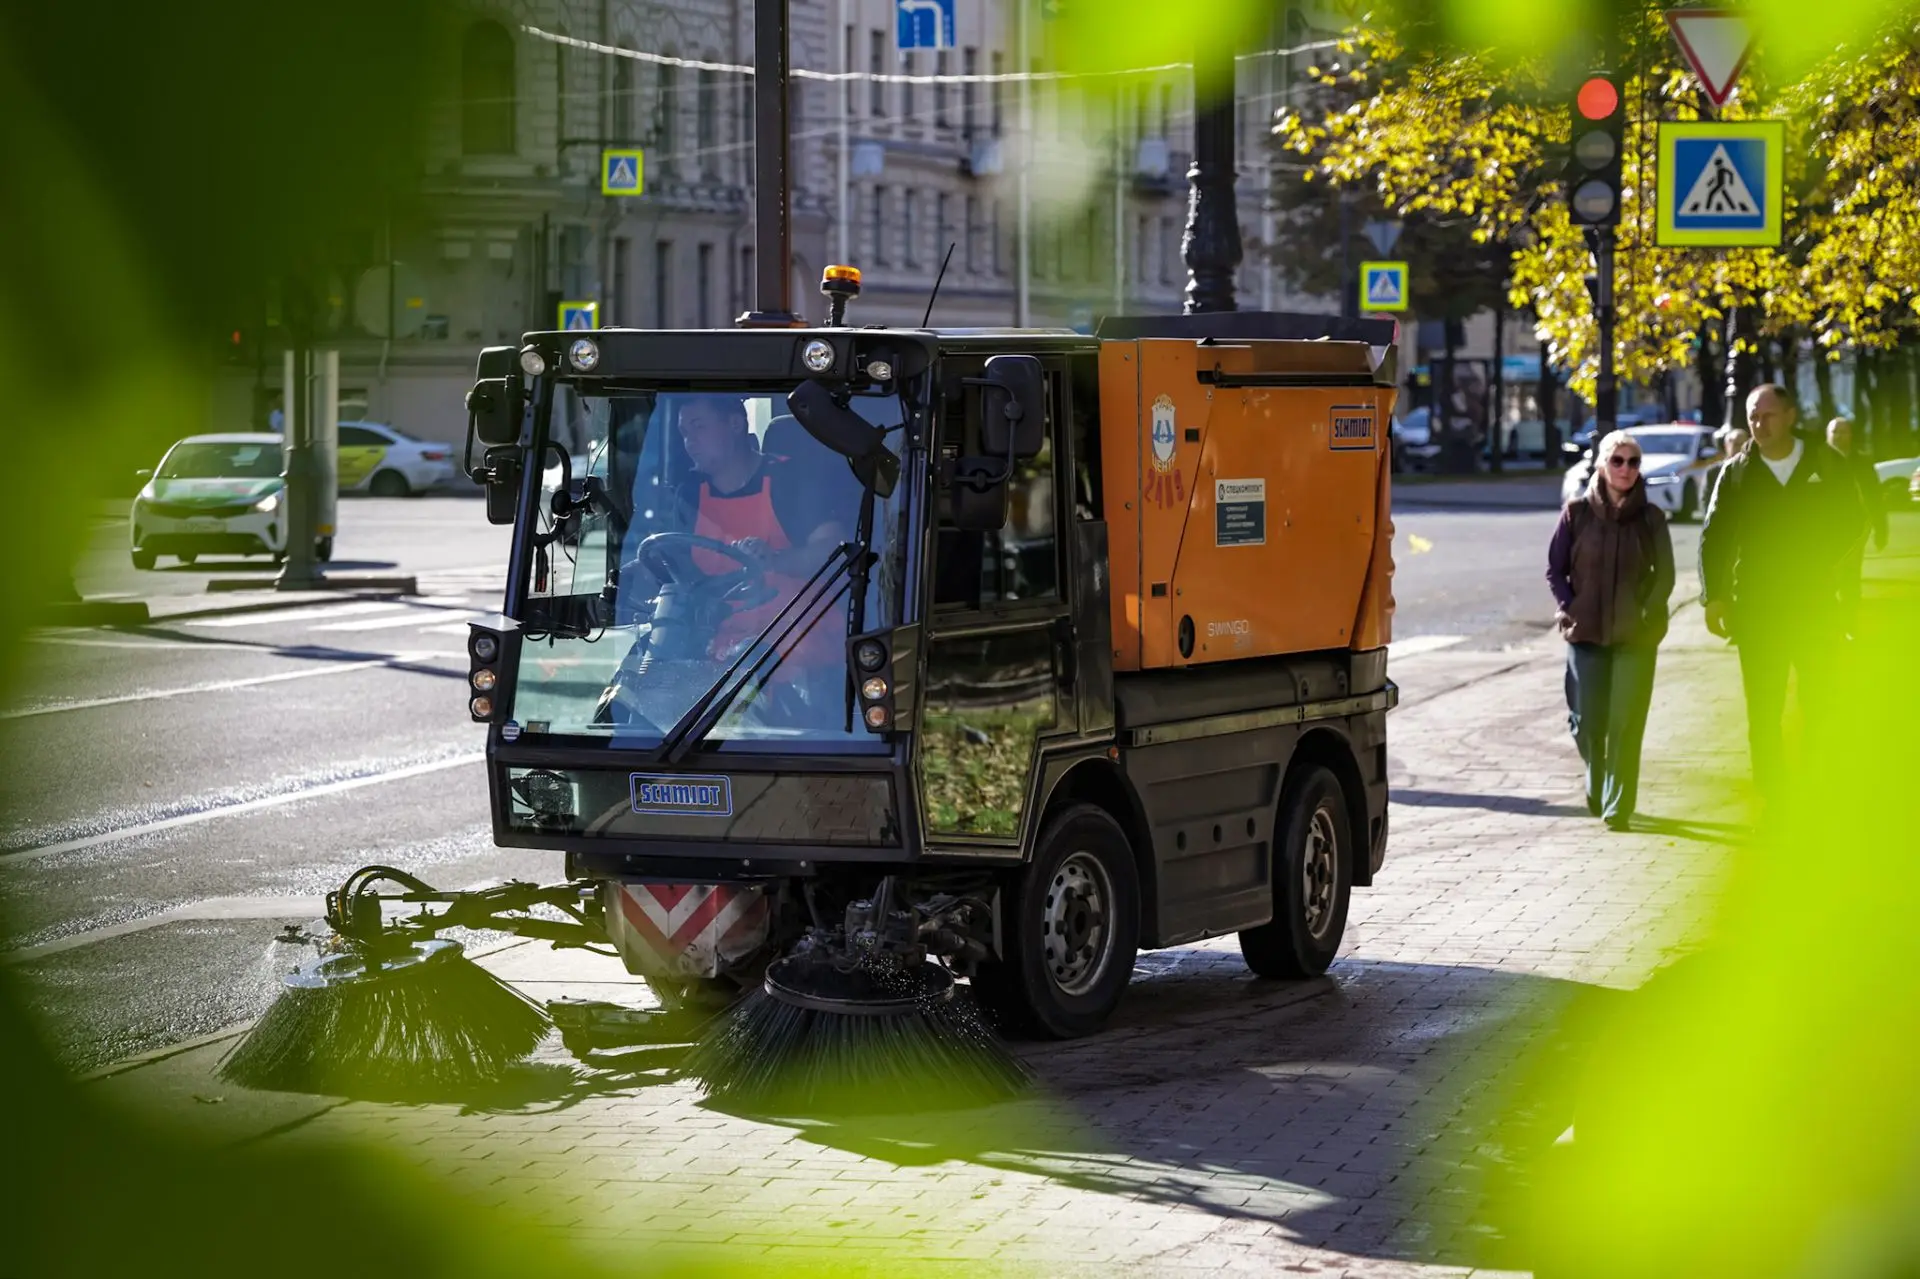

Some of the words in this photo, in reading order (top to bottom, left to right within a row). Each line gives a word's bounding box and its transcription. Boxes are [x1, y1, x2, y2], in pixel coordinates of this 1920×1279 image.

[1335, 417, 1372, 438] SCHMIDT
[1207, 619, 1249, 637] SWINGO
[640, 783, 720, 805] SCHMIDT
